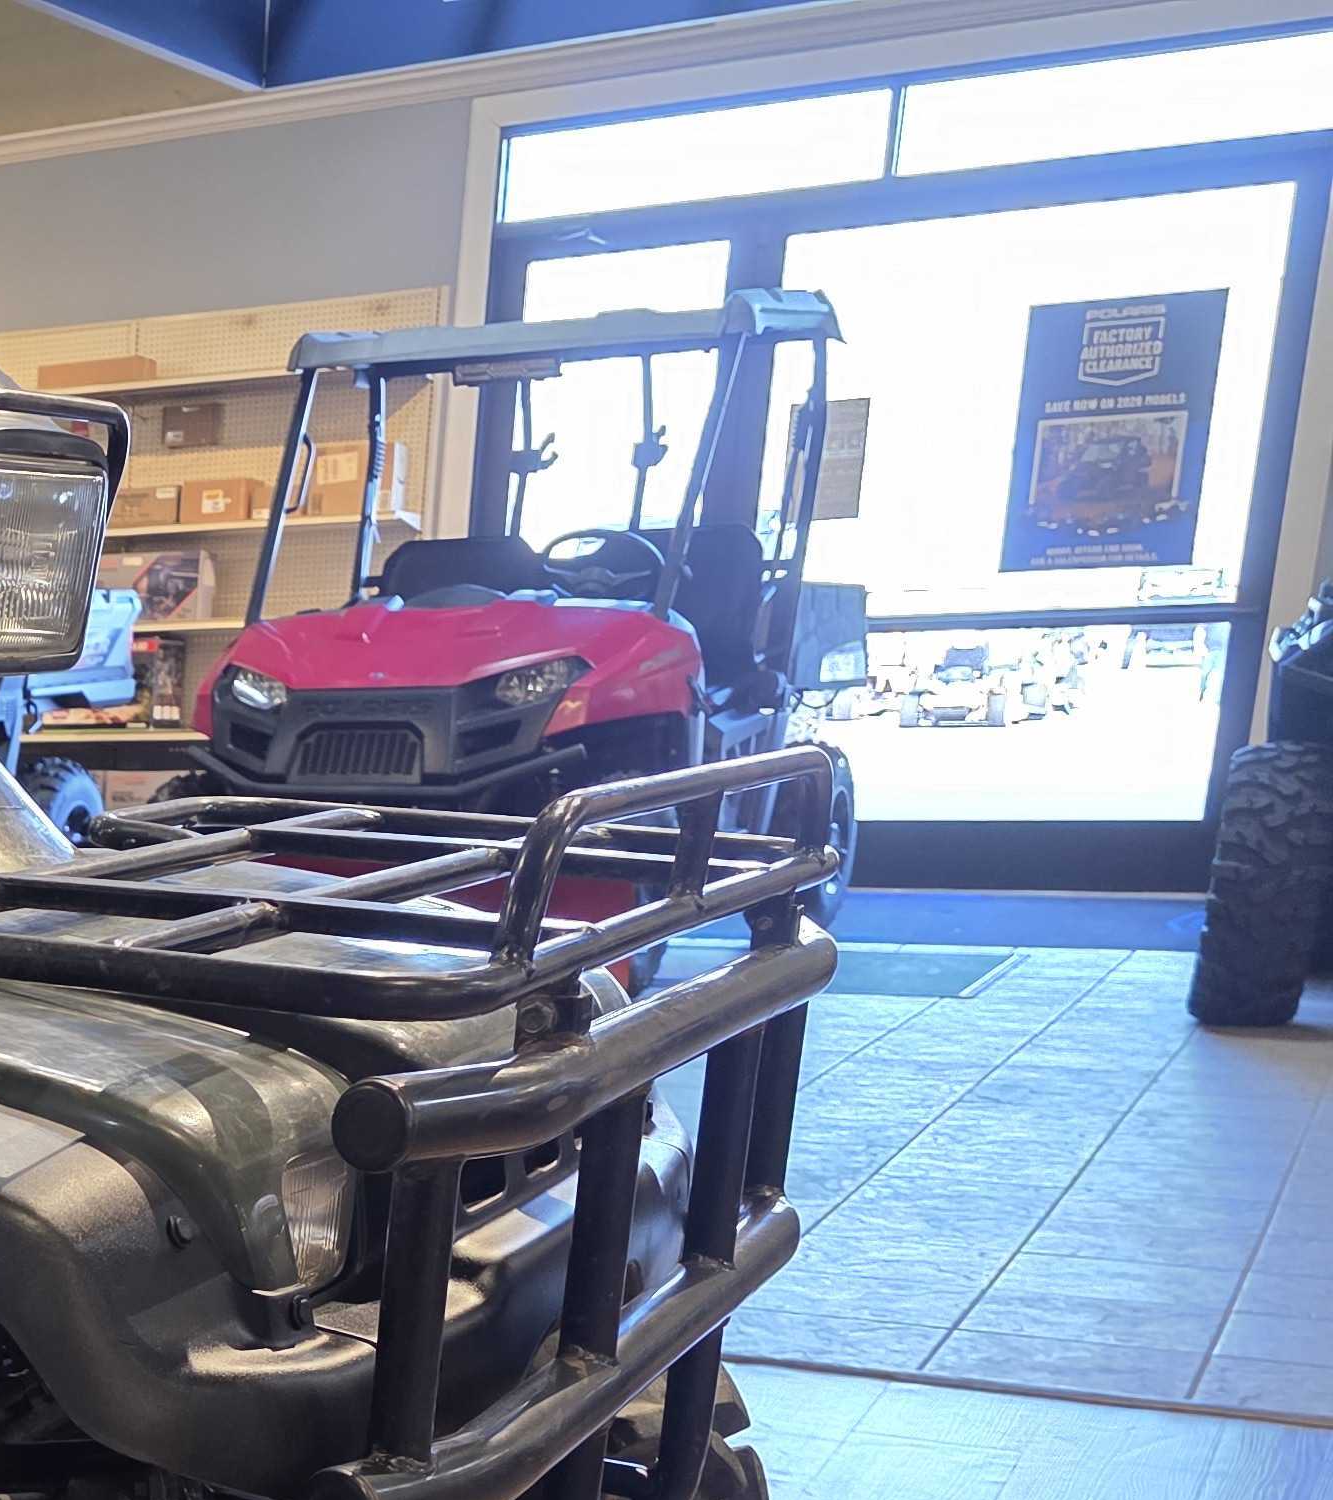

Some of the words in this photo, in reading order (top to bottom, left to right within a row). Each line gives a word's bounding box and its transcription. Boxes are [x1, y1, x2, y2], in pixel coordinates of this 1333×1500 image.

[1093, 326, 1153, 344] FACTORY
[1081, 340, 1163, 359] AUTHORIZED
[1084, 356, 1153, 374] CLEARANCE
